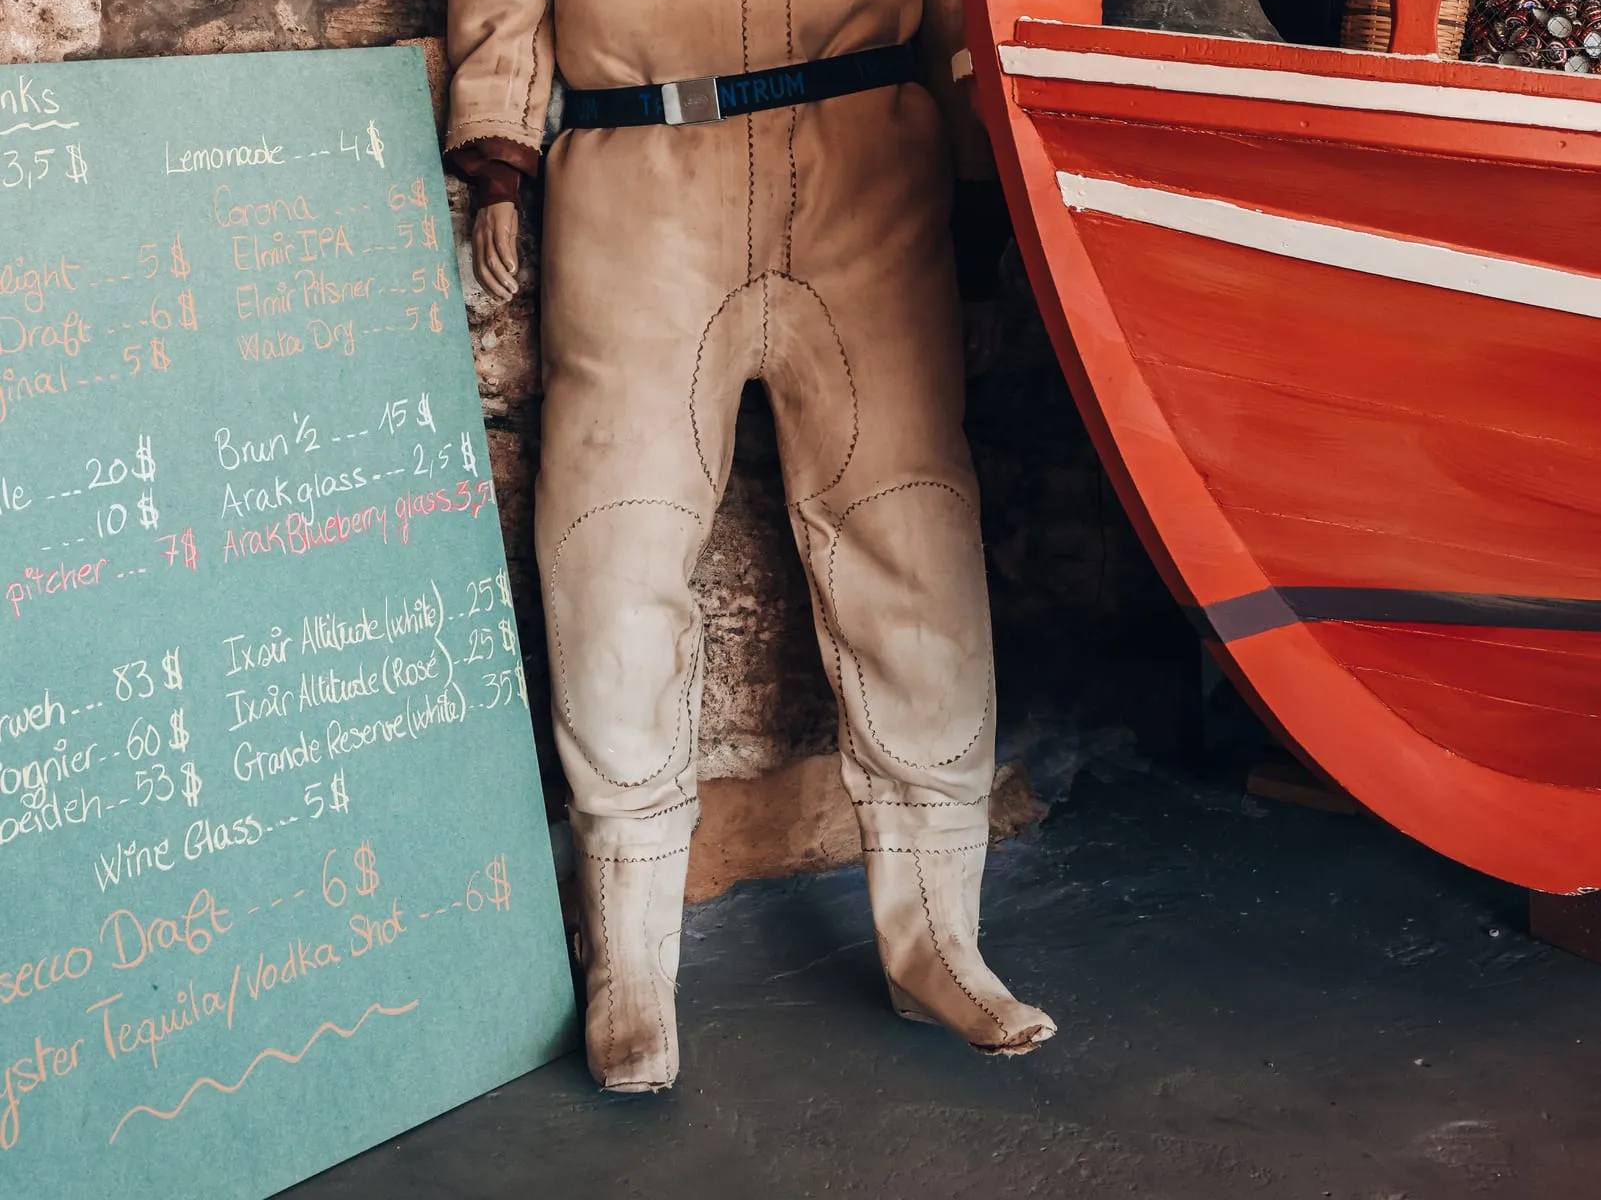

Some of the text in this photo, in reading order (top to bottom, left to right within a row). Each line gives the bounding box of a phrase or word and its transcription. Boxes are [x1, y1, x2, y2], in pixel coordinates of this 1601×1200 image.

[165, 133, 285, 176] Lemonade
[213, 184, 317, 228] Corona
[296, 224, 354, 261] IPA
